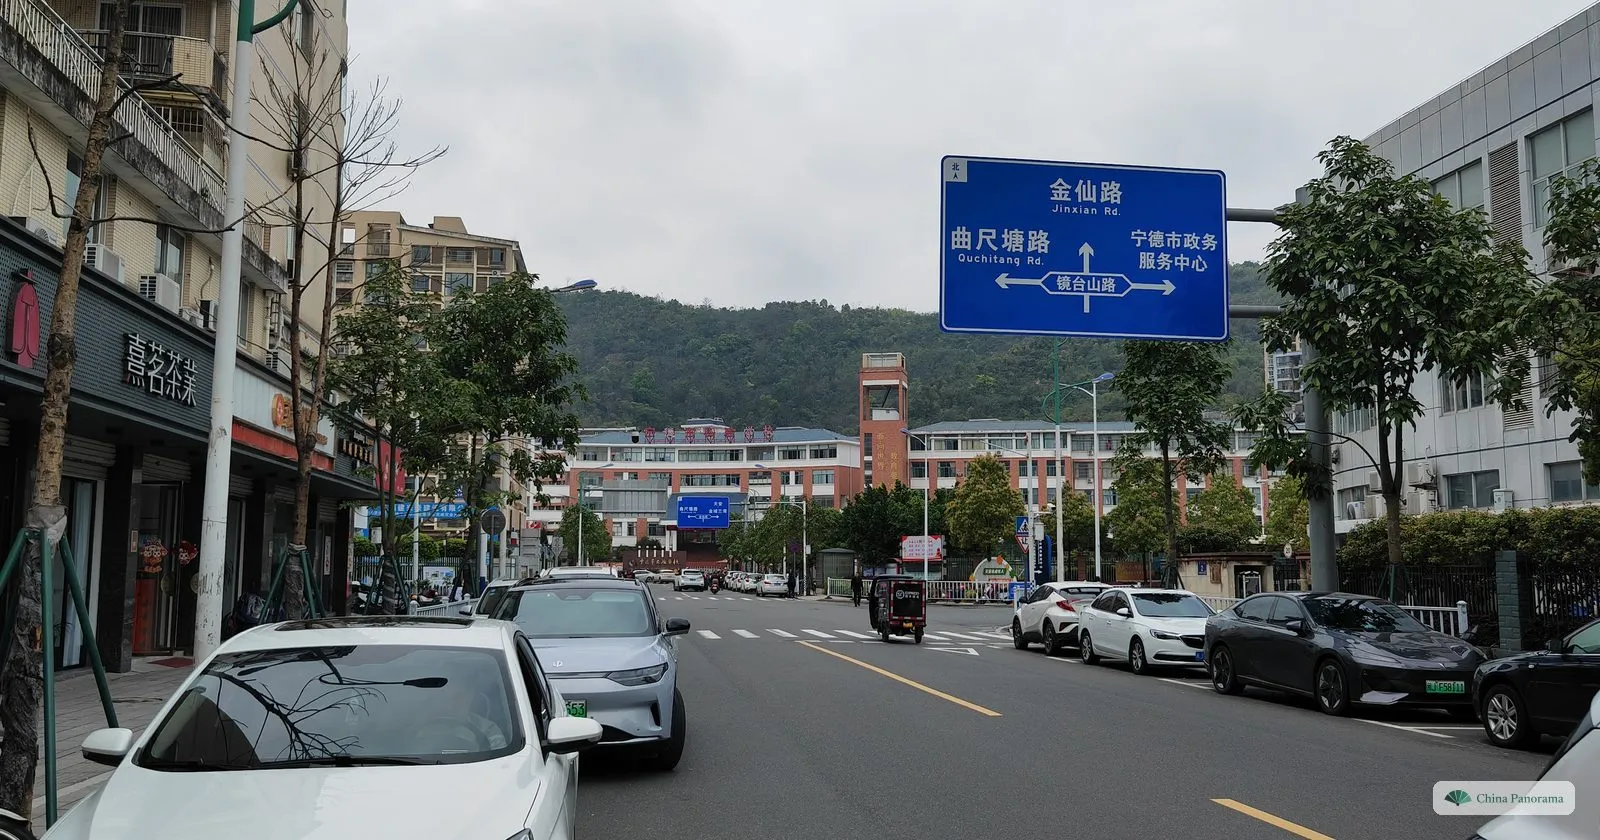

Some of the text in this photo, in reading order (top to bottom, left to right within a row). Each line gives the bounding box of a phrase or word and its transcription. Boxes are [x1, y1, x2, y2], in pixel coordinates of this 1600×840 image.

[951, 162, 960, 171] 北
[1049, 178, 1123, 205] 金仙路
[1051, 204, 1121, 216] Jinxian Rd.
[951, 226, 1051, 254] 曲尺塘路
[1130, 229, 1218, 251] 宁德市政务
[958, 253, 1044, 267] Quchitang Rd.
[1139, 252, 1208, 273] 服务中心
[1056, 275, 1116, 293] 镜台山路
